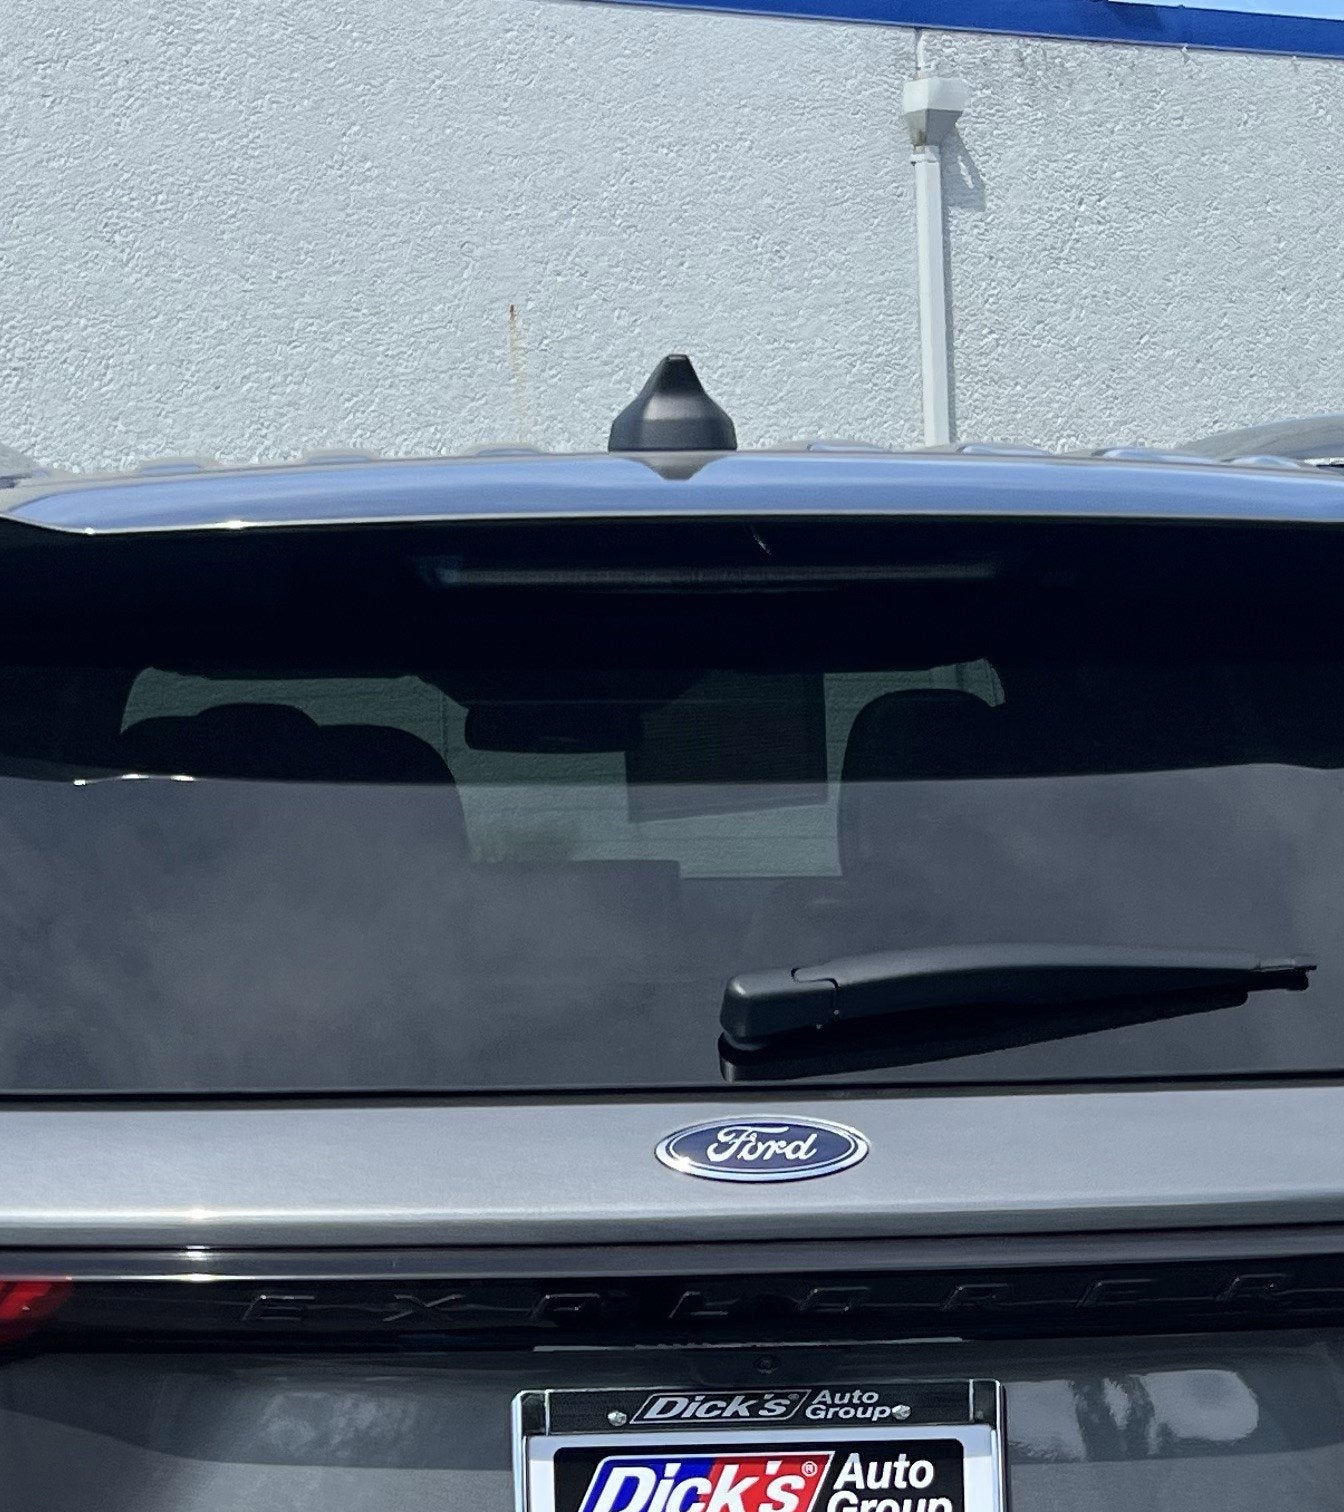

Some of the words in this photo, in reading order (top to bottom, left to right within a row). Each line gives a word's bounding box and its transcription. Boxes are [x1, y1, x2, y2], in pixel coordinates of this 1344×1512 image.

[707, 1125, 818, 1162] Ford
[812, 1389, 879, 1405] Auto
[805, 1404, 893, 1421] Group
[833, 1452, 935, 1490] Auto
